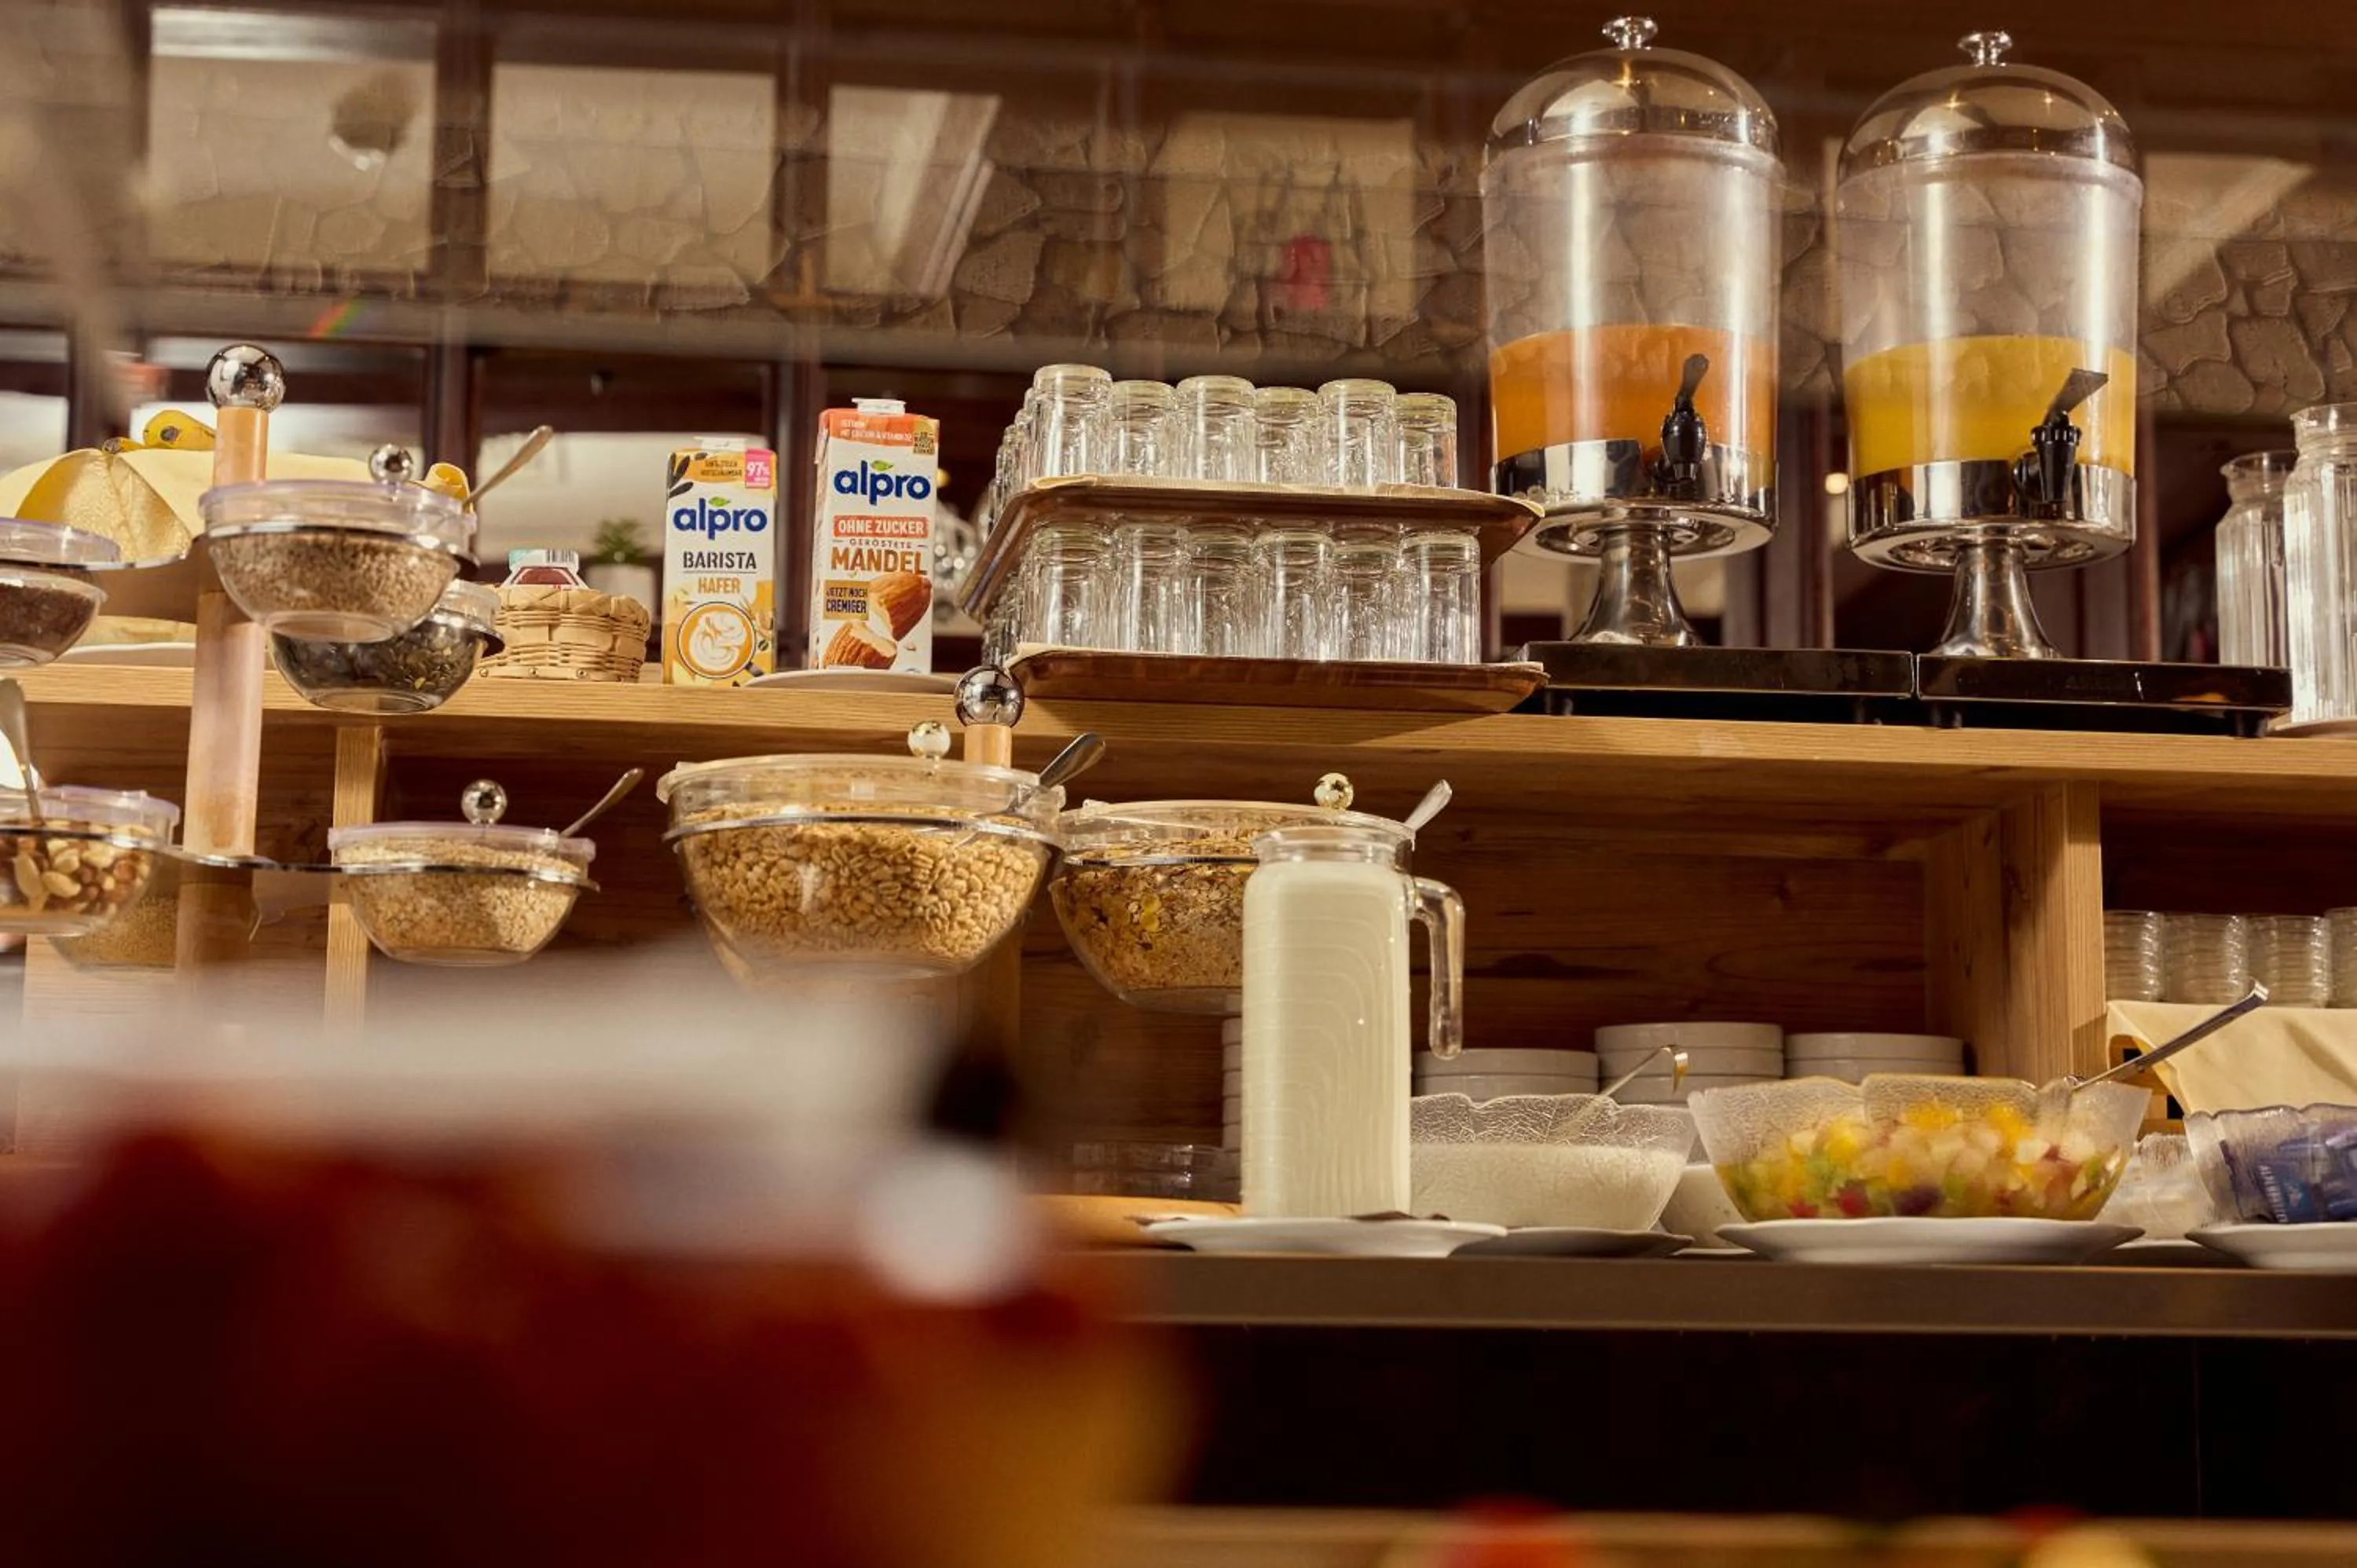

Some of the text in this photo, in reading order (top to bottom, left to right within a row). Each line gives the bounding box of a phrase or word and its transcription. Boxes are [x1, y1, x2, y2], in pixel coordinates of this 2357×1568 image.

[834, 460, 931, 506] alpro
[673, 497, 768, 540] alpro
[838, 519, 925, 535] OHNE ZUCKER
[683, 551, 757, 570] BARISTA
[830, 546, 927, 575] MANDEL
[698, 577, 741, 594] HAFER
[826, 587, 848, 598] JETZT
[826, 599, 867, 614] CREMIGER
